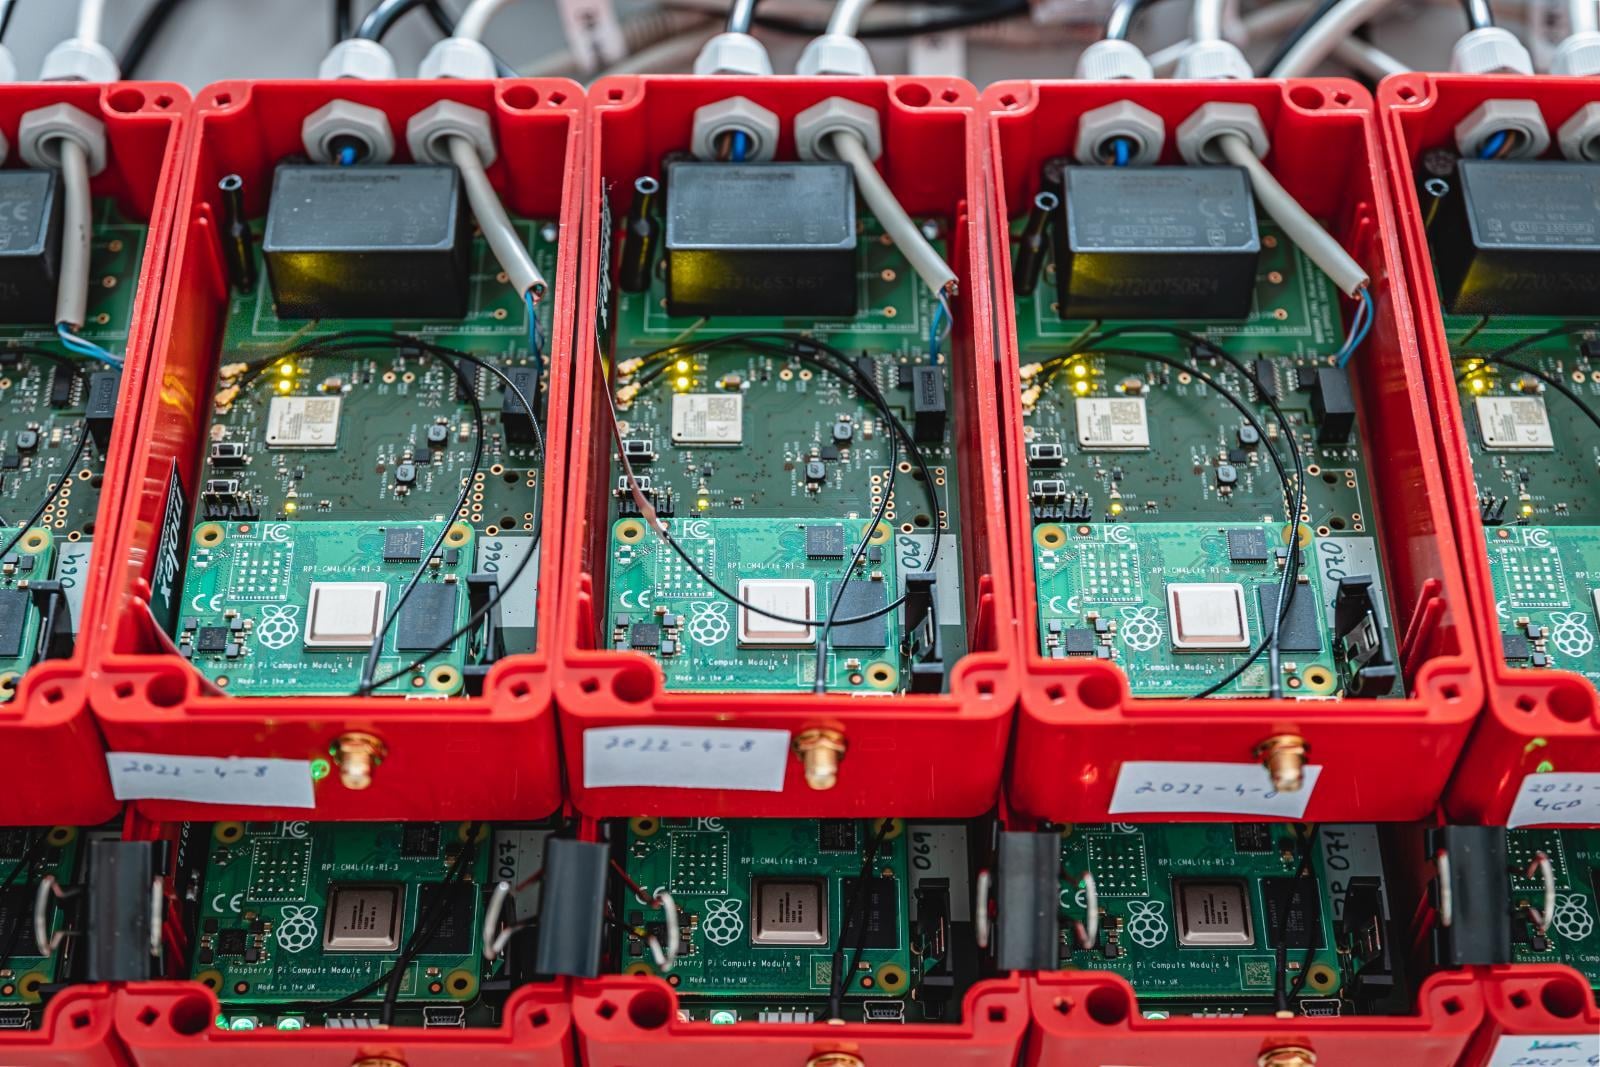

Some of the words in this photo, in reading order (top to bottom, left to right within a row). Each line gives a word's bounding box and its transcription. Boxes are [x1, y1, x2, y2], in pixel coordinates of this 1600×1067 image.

[160, 486, 184, 609] molex
[899, 536, 921, 569] 068
[483, 542, 503, 573] 066
[1320, 541, 1347, 582] 070
[303, 565, 381, 573] RPI-CM4Lite-R1-3
[192, 593, 224, 612] CE
[620, 589, 651, 609] CE
[1049, 595, 1080, 613] CE
[1496, 600, 1511, 618] E
[208, 661, 253, 670] Raspberry
[258, 661, 269, 670] Pi
[273, 661, 307, 670] Compute
[311, 661, 345, 670] Module
[348, 661, 353, 670] 4
[693, 658, 705, 666] Pi
[708, 658, 744, 666] Compute
[748, 658, 780, 666] Module
[783, 658, 788, 666] 4
[1130, 664, 1143, 672] Pi
[1146, 664, 1181, 672] Compute
[1185, 664, 1216, 672] Module
[1220, 664, 1225, 672] 4
[912, 832, 932, 870] 069
[1323, 830, 1350, 871] 071
[498, 839, 518, 879] 067
[741, 857, 818, 865] RPI-CM4Lite-R1-3
[1158, 858, 1235, 866] RPI-CM4Lite-R1-3
[321, 863, 399, 872] RPI-CM4Lite-R1-3
[212, 893, 243, 913] CE
[708, 958, 717, 968] Pi
[722, 958, 755, 968] Compute
[761, 958, 791, 968] Module
[794, 958, 801, 968] 4
[1088, 961, 1132, 971] Raspberry
[1137, 961, 1146, 971] Pi
[1151, 961, 1184, 971] Compute
[1190, 961, 1221, 971] Module
[1224, 961, 1230, 971] 4
[228, 965, 273, 975] Raspberry
[278, 965, 289, 975] Pi
[292, 965, 327, 975] Compute
[331, 965, 361, 975] Module
[365, 965, 371, 975] 4
[689, 976, 706, 984] Made
[711, 976, 719, 984] in
[723, 976, 737, 984] the
[739, 976, 748, 984] UK
[1141, 978, 1150, 986] in
[1154, 978, 1167, 986] the
[1169, 978, 1178, 986] UK
[257, 983, 275, 991] Made
[279, 983, 287, 991] in
[291, 983, 304, 991] the
[307, 983, 317, 991] UK
